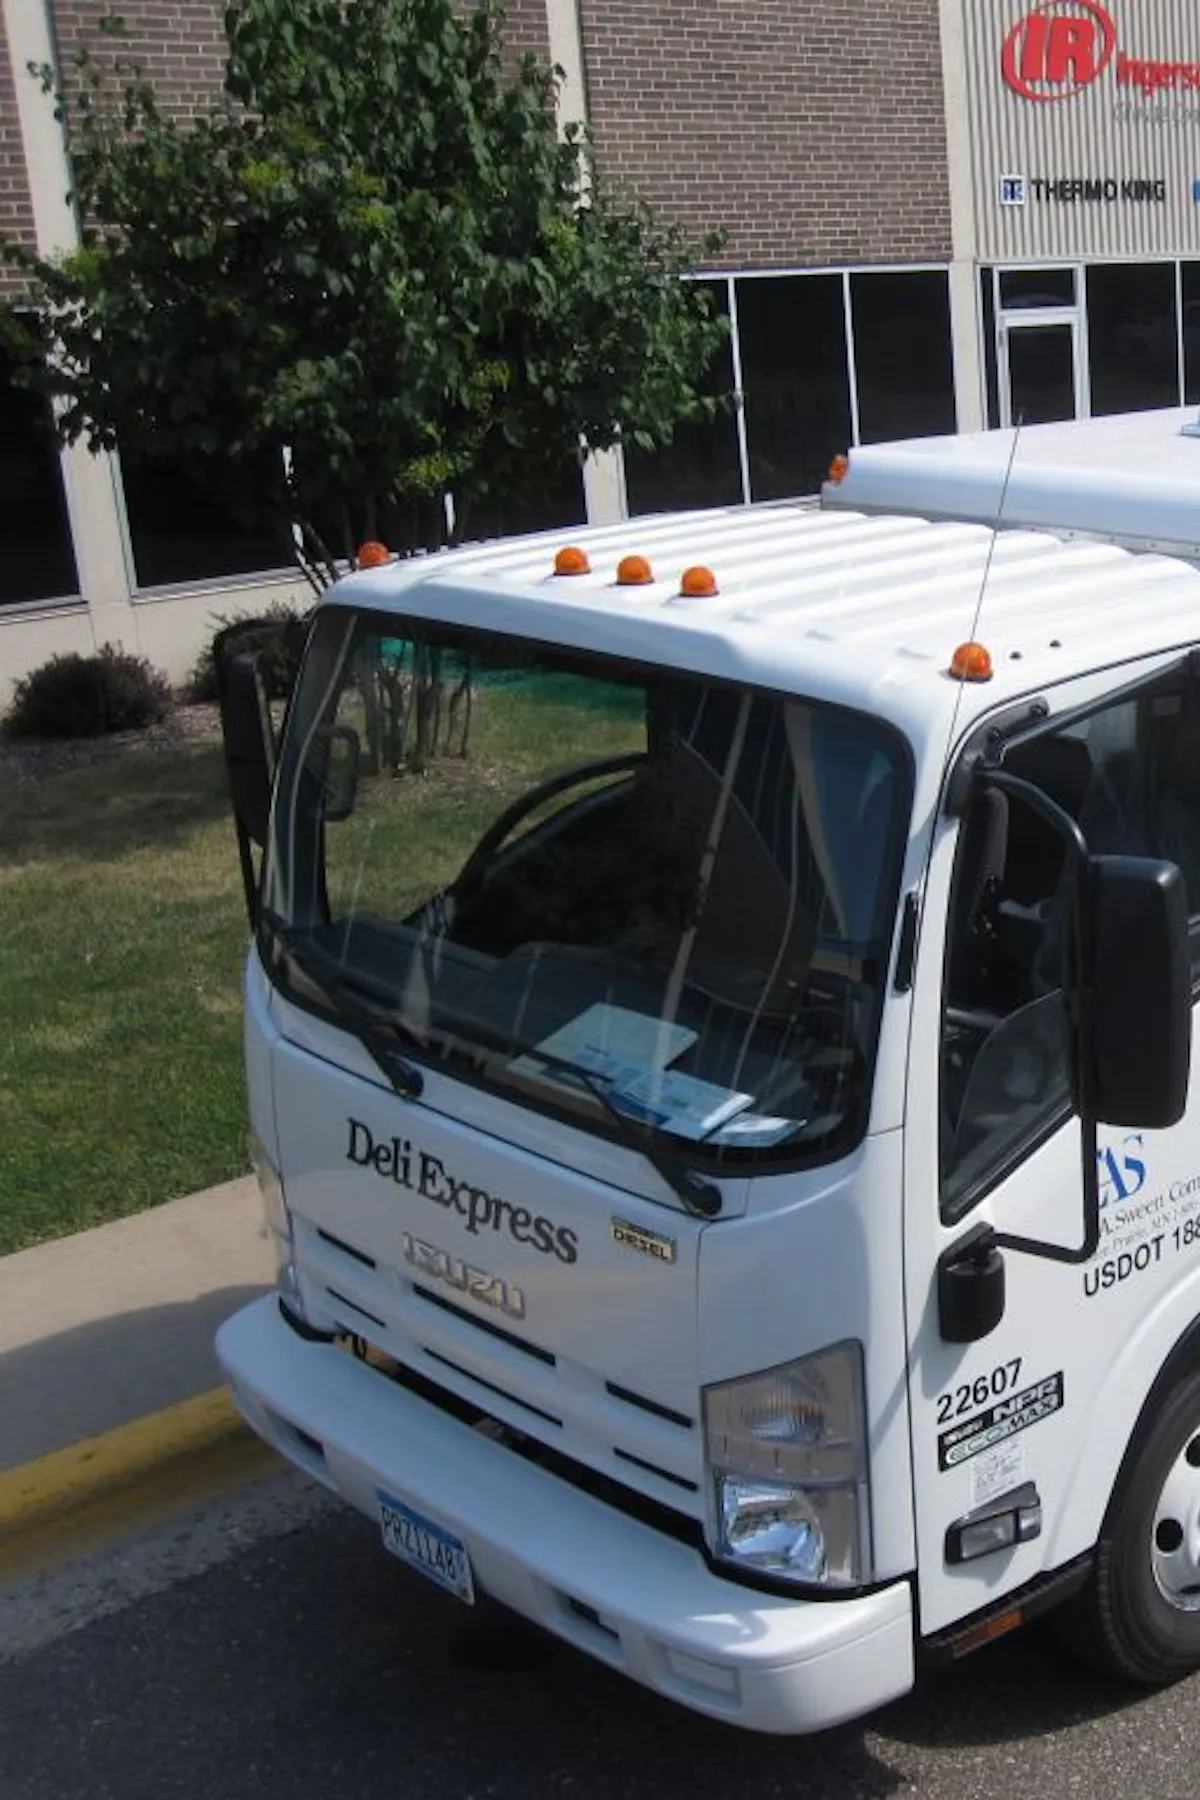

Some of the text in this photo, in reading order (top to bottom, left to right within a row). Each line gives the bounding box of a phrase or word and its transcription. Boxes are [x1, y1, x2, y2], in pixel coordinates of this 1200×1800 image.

[1031, 179, 1117, 201] THERMO
[1121, 179, 1166, 201] KING
[347, 1117, 578, 1265] Deli Express
[402, 1231, 526, 1321] ISUZU
[1084, 1233, 1166, 1297] USDOT
[937, 1357, 1023, 1424] 22607
